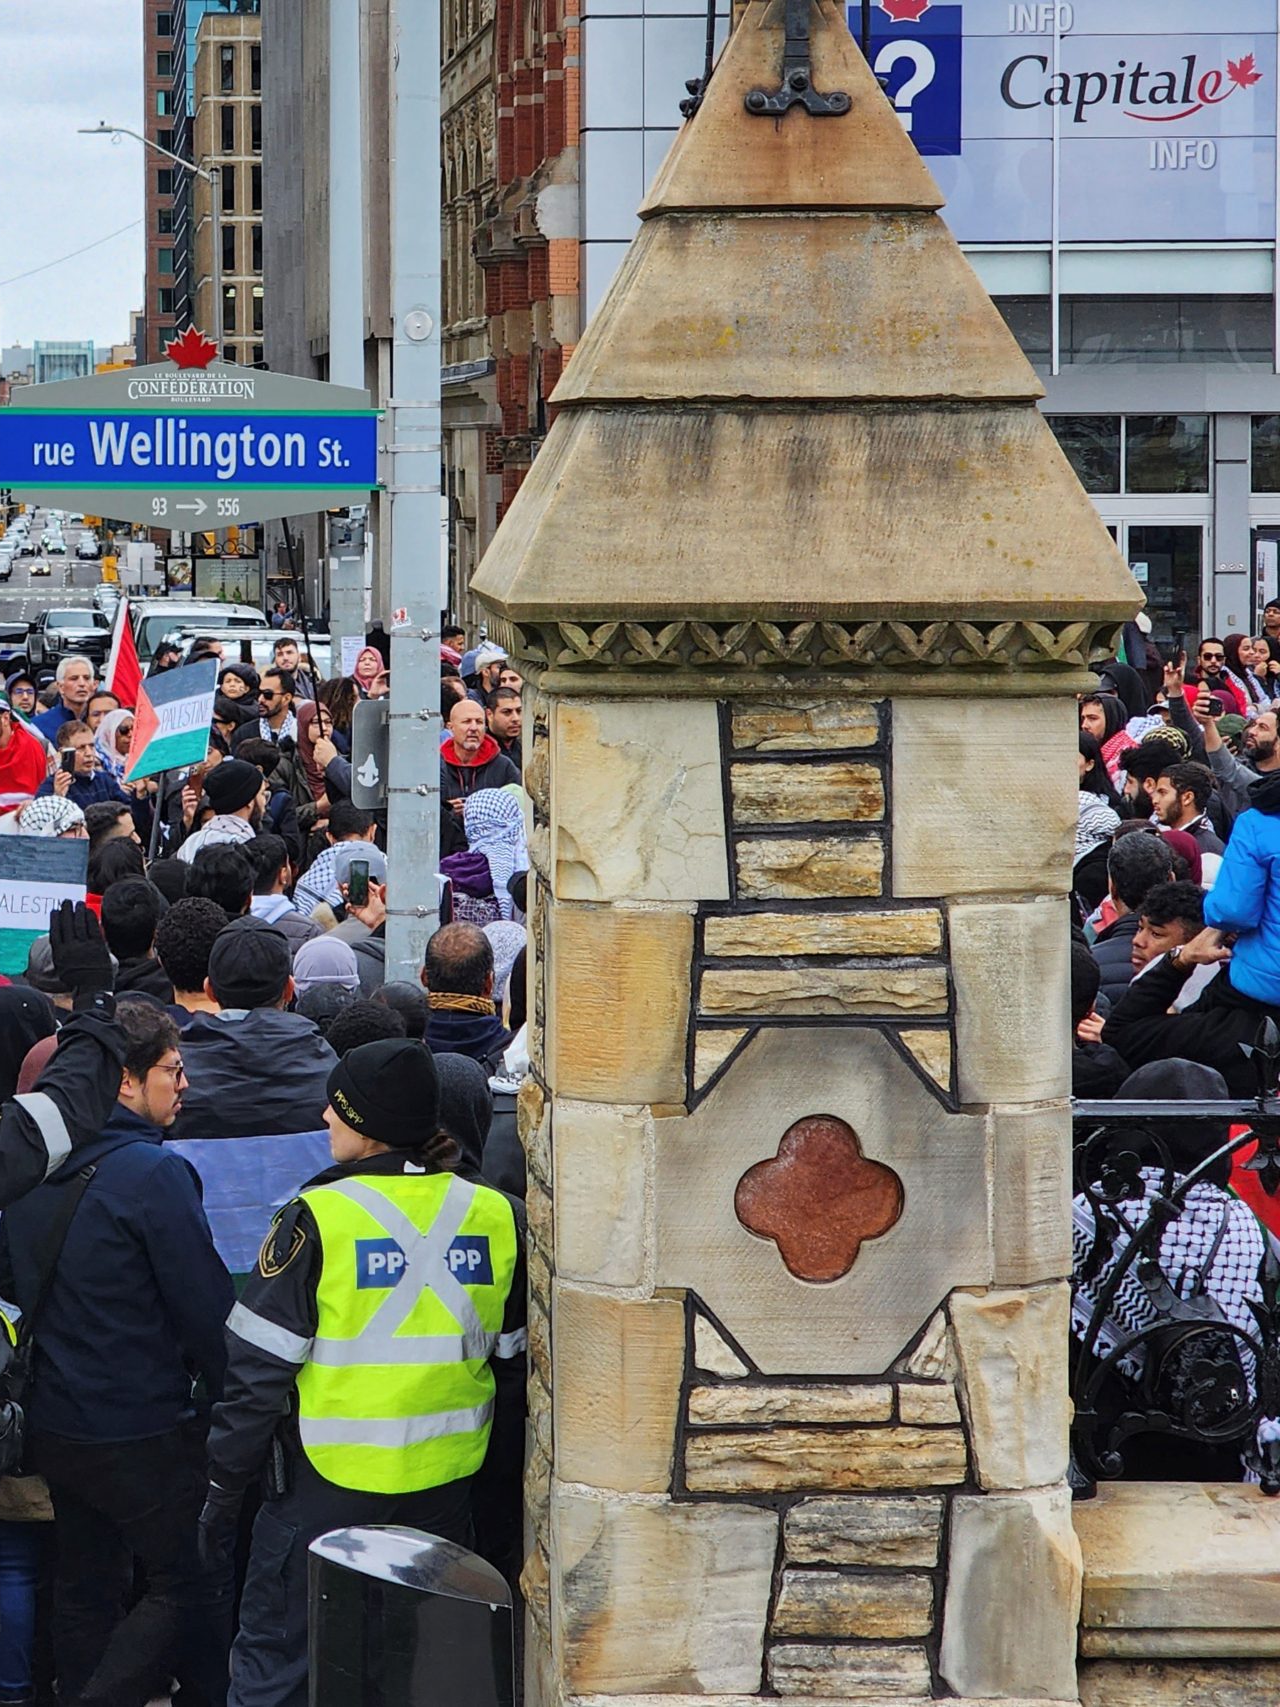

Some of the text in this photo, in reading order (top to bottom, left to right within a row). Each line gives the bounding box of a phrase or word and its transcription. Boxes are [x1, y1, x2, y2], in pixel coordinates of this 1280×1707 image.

[1008, 4, 1074, 33] INFO
[1000, 54, 1224, 123] Capitale
[1149, 140, 1216, 170] INFO
[128, 378, 255, 400] CONFÉDÉRATION
[33, 418, 350, 480] rue Wellington St.
[152, 497, 240, 516] 93 556
